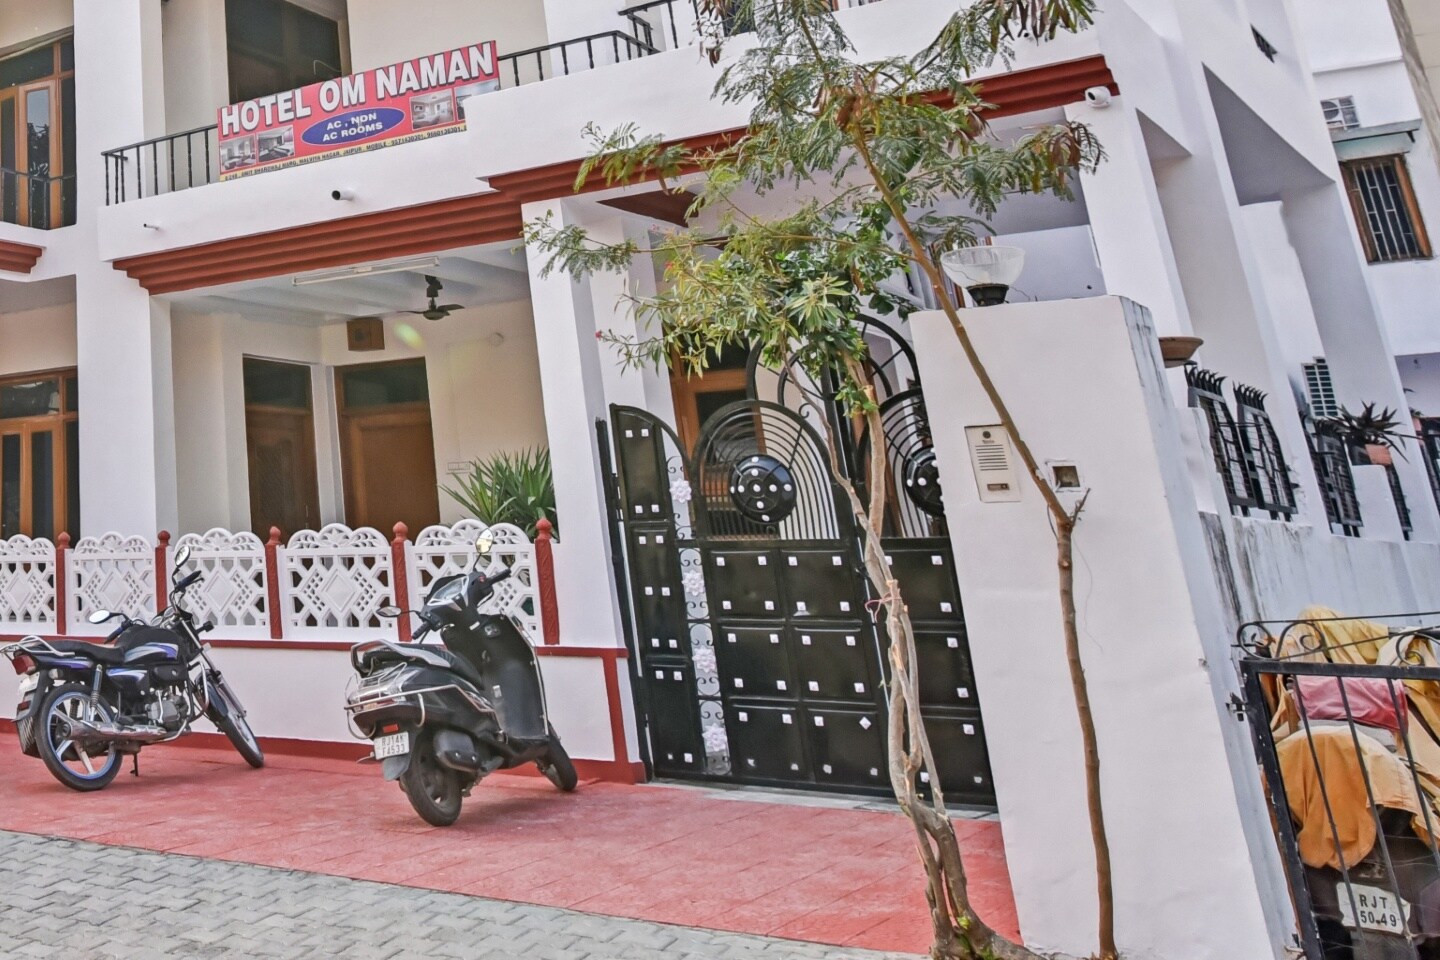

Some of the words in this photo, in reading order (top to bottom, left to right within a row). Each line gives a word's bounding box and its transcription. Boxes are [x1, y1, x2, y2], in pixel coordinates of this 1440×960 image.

[221, 88, 311, 136] HOTEL
[319, 73, 366, 112] OM
[376, 42, 494, 100] NAMAN
[322, 131, 338, 142] AC
[341, 121, 383, 139] ROOMS
[326, 119, 342, 131] AC
[1359, 893, 1388, 910] RJT
